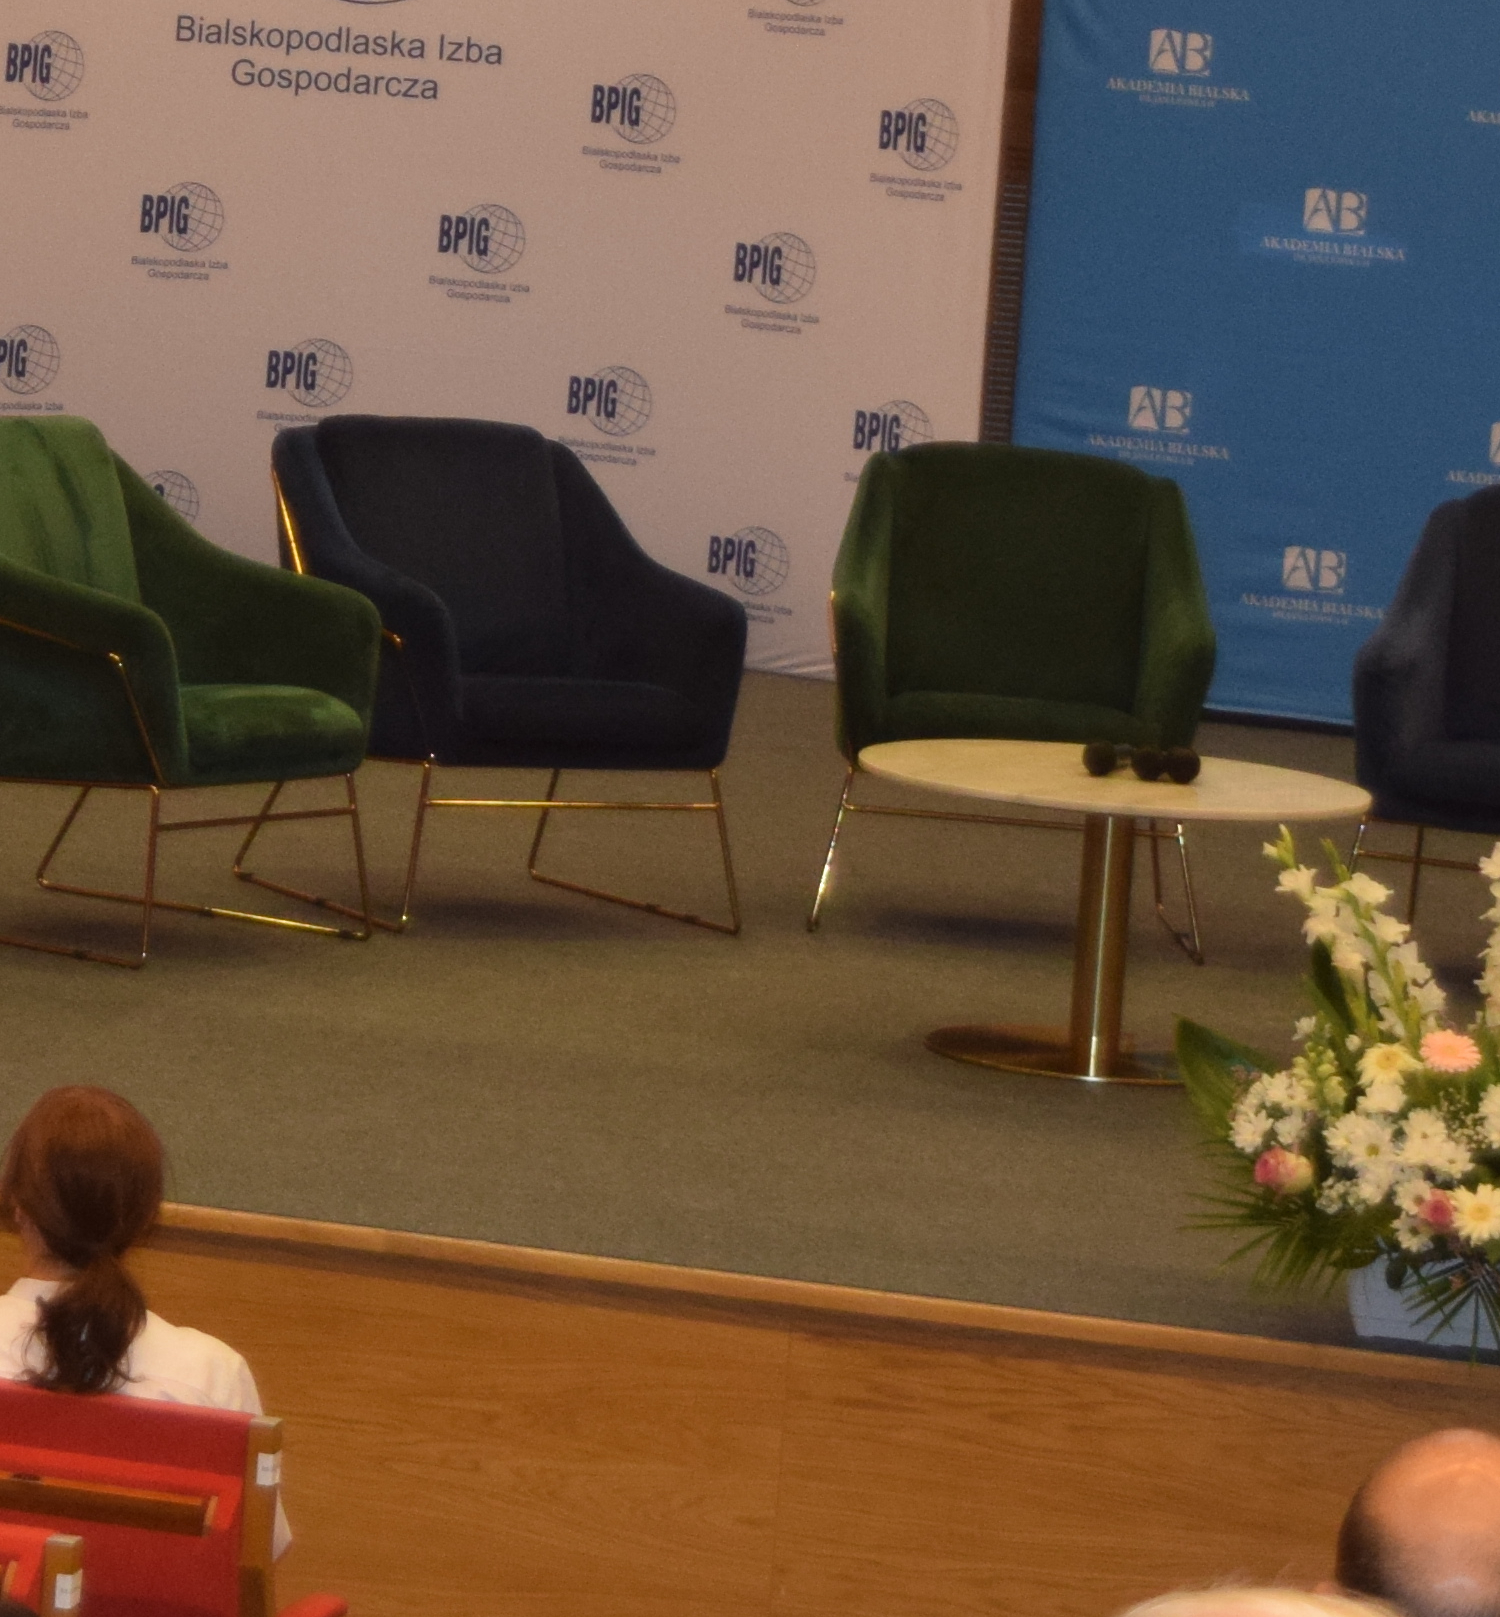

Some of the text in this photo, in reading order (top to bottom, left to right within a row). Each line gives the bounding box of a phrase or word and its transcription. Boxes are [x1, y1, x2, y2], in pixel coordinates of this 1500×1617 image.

[175, 15, 503, 67] Bialskopodlaska Izba
[5, 43, 52, 84] BPIG
[231, 59, 440, 101] Gospodarcza
[591, 83, 641, 127] BPIG
[1105, 76, 1250, 101] AKADEMIA BIALSKA
[879, 109, 927, 154] BPIG
[140, 194, 189, 235] BPIG
[438, 214, 489, 257] BPIG
[734, 242, 782, 286] BPIG
[265, 349, 317, 391] BPIG
[567, 376, 617, 419] BPIG
[854, 410, 900, 454] BPIG
[708, 535, 756, 579] BPIG
